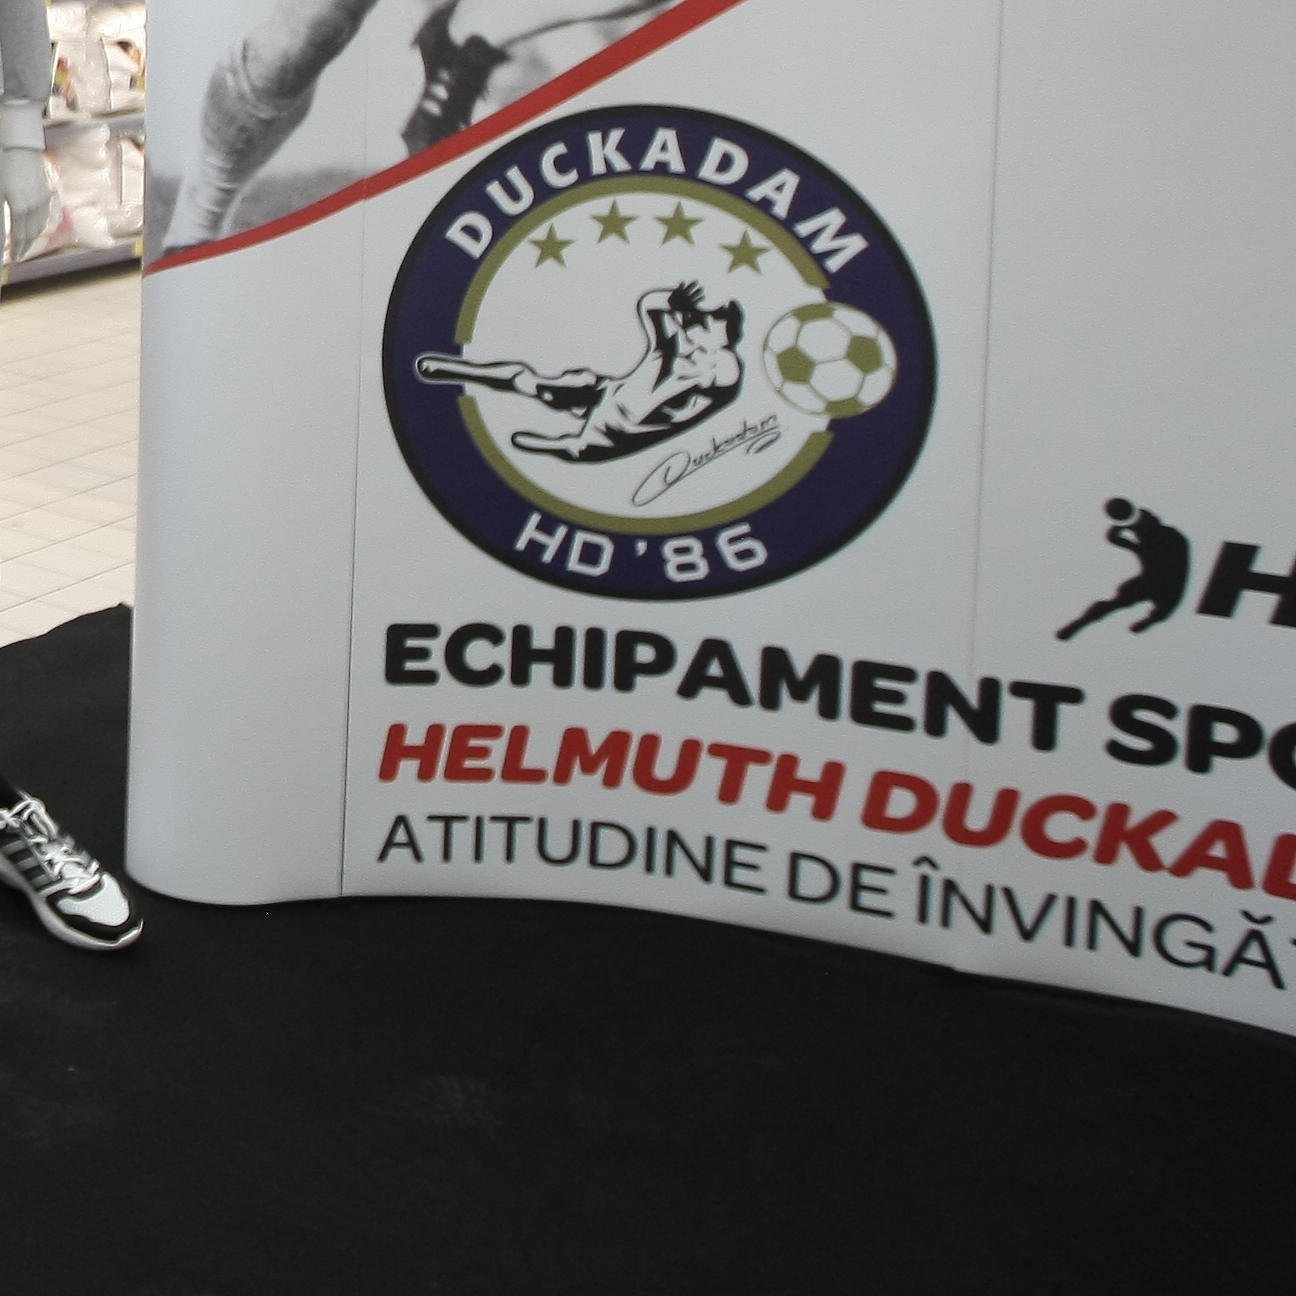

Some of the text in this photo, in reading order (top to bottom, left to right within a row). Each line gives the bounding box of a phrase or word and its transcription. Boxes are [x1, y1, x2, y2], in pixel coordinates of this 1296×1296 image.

[445, 128, 869, 273] DUCKADAM
[514, 512, 615, 577] HD
[384, 623, 1085, 752] ECHIPAMENT
[378, 722, 846, 822] HELMUTH
[377, 814, 1296, 990] ATITUDINE DE ÎNVINGĂ
